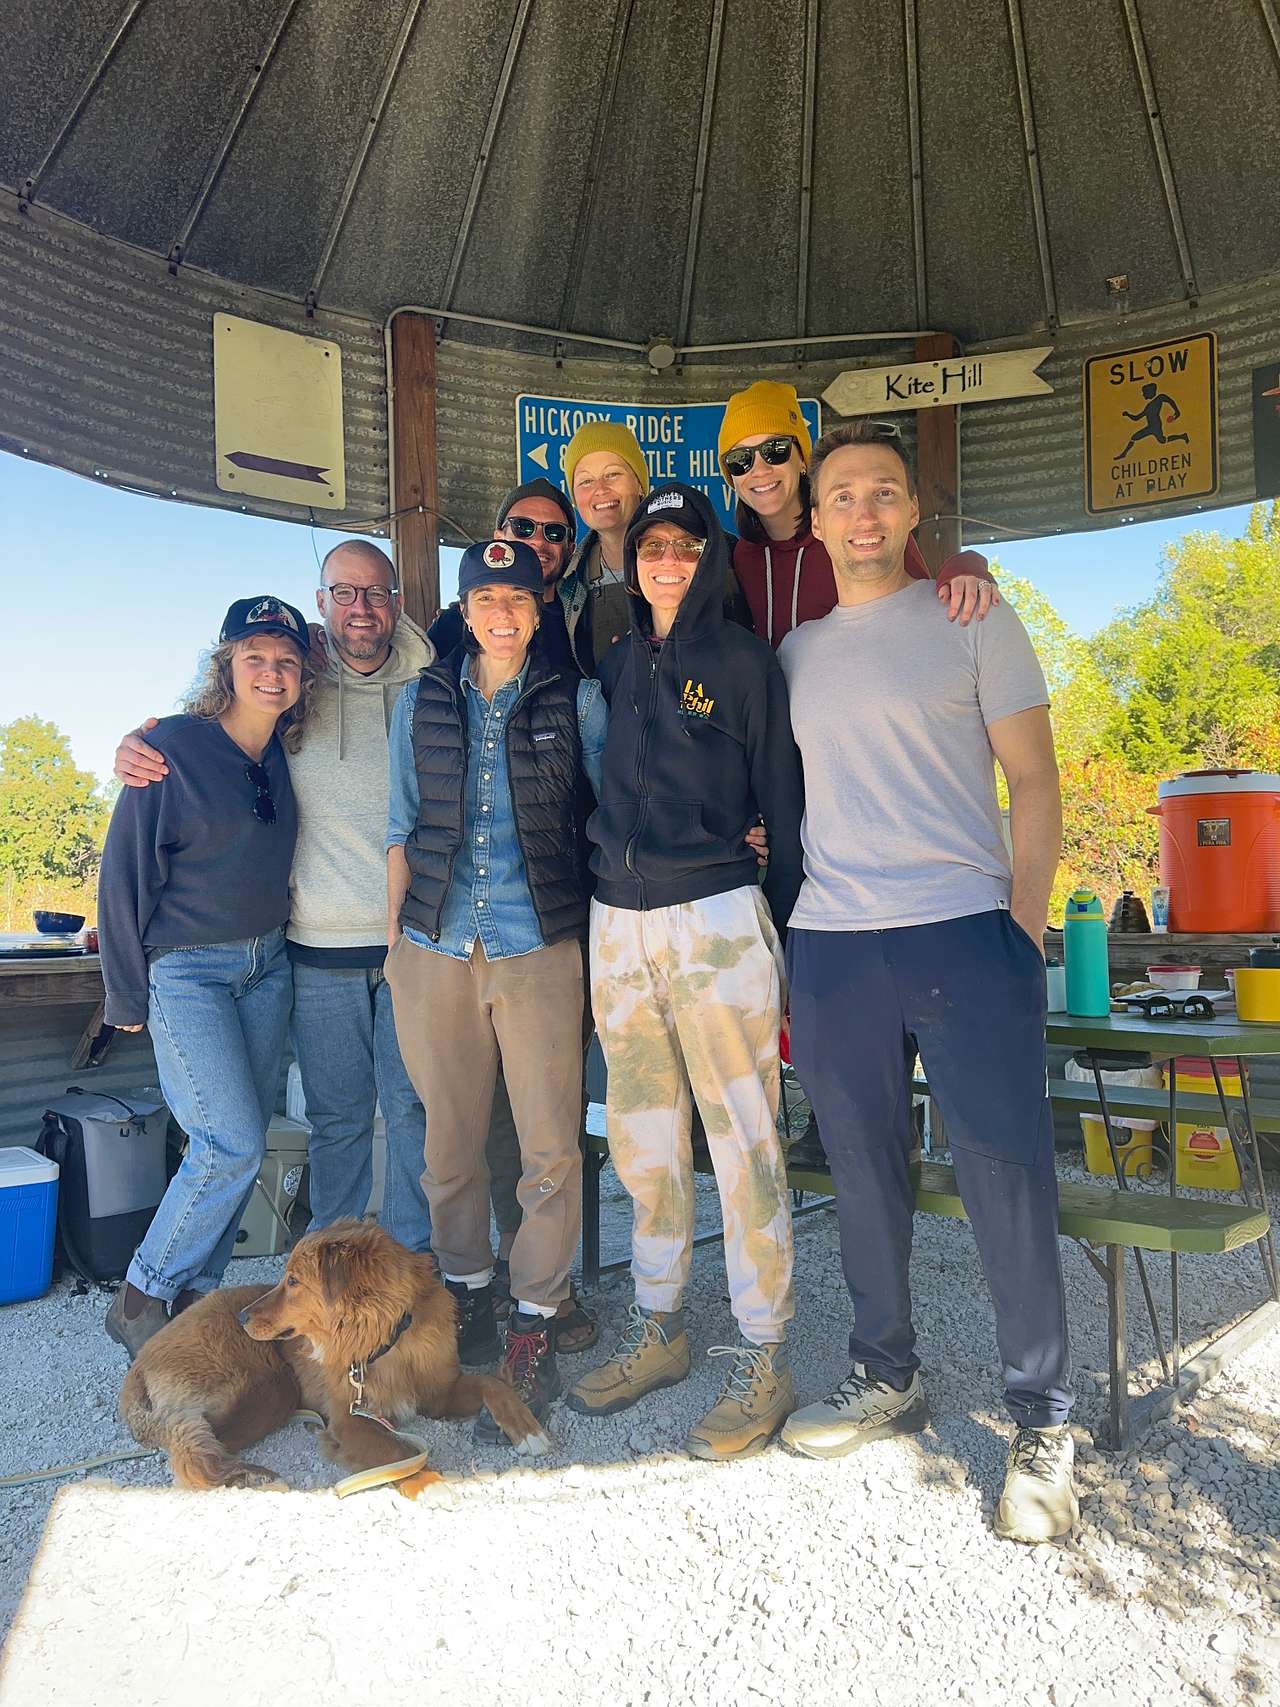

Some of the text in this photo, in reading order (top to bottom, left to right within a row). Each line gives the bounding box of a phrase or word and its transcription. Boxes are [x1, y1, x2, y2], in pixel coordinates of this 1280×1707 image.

[886, 363, 982, 400] Kite Hill
[1110, 349, 1189, 385] SLOW
[626, 414, 684, 443] RIDGE
[1111, 452, 1191, 480] CHILDREN
[1115, 472, 1187, 498] AT PLAY
